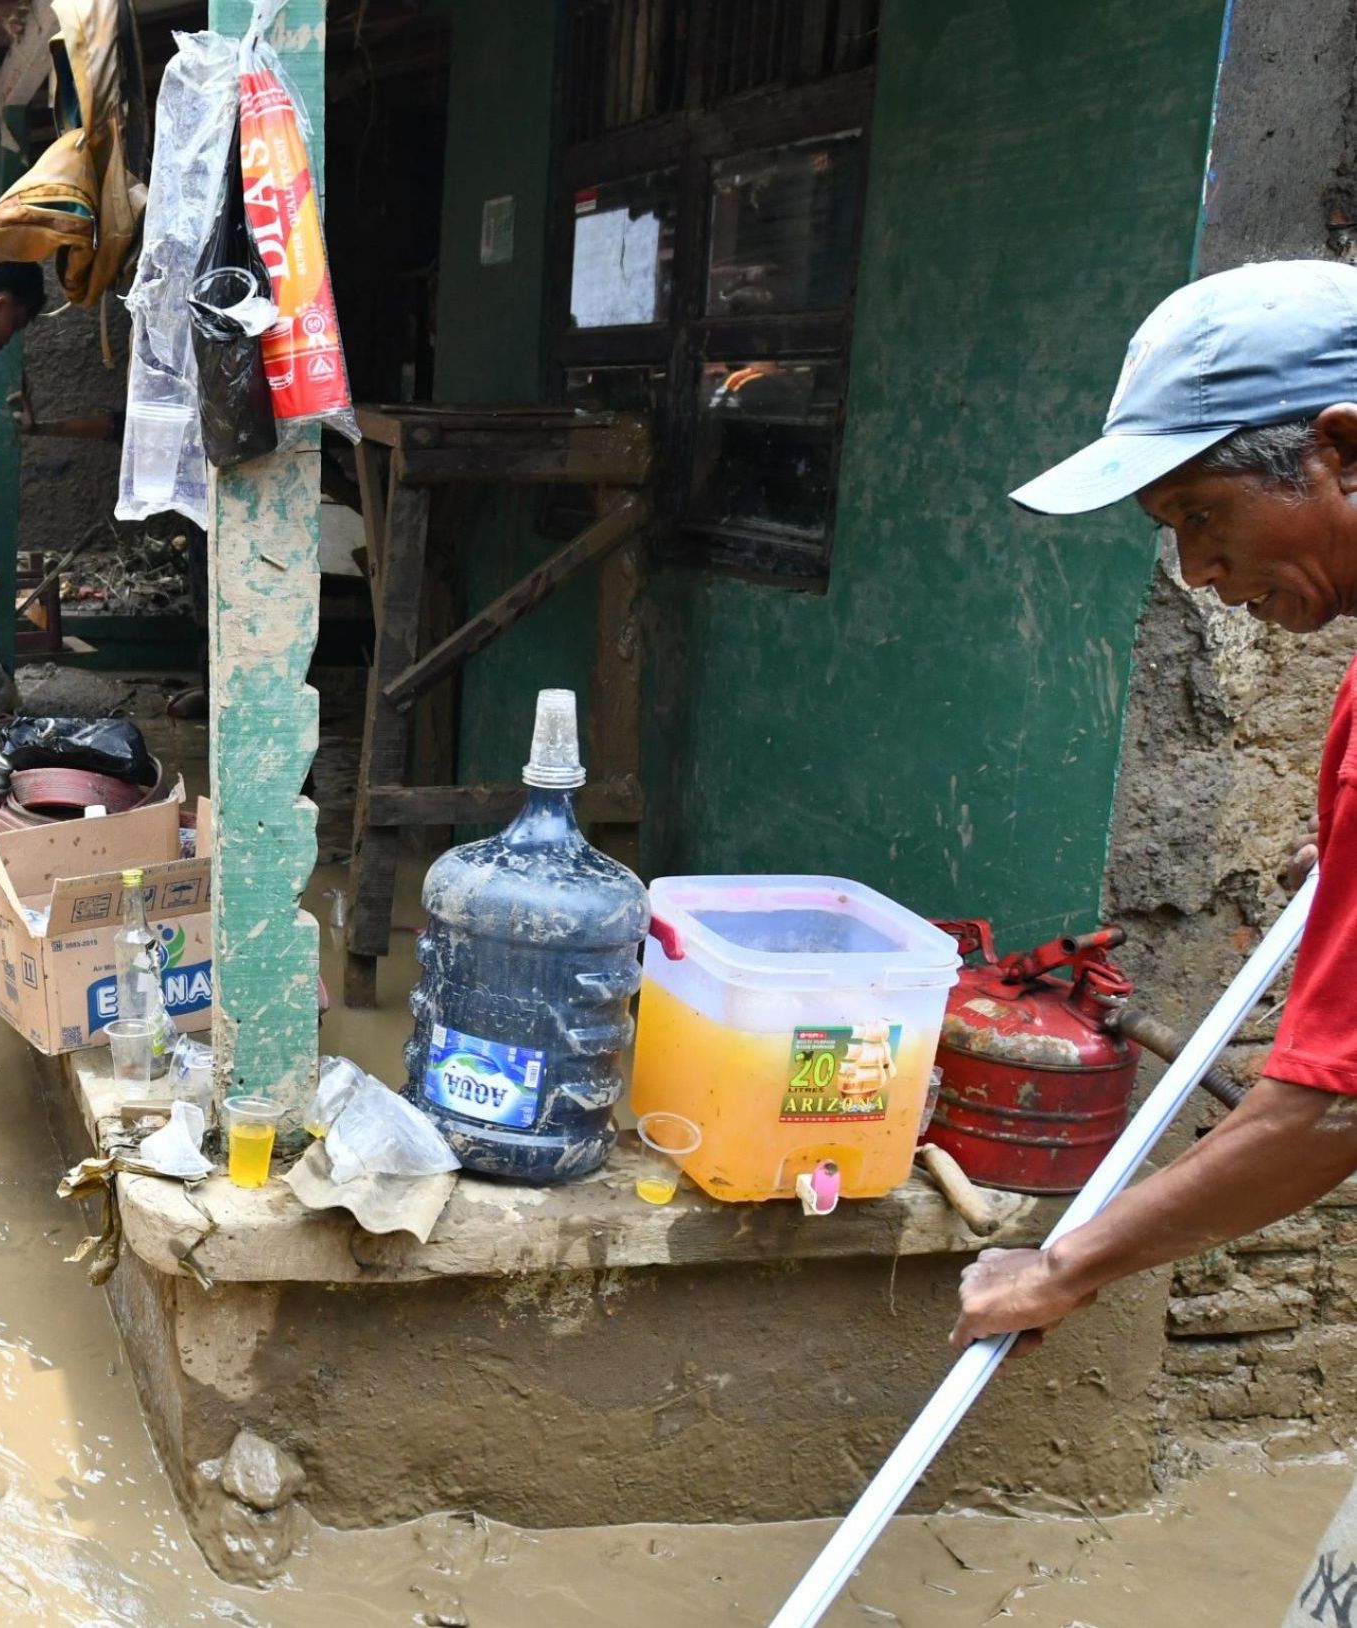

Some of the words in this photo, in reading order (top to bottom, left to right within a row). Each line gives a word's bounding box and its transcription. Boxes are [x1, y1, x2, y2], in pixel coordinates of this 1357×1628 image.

[241, 136, 291, 281] DIAS
[789, 1052, 836, 1087] 20
[444, 1071, 508, 1107] AQUA
[784, 1096, 884, 1113] ARIZONA
